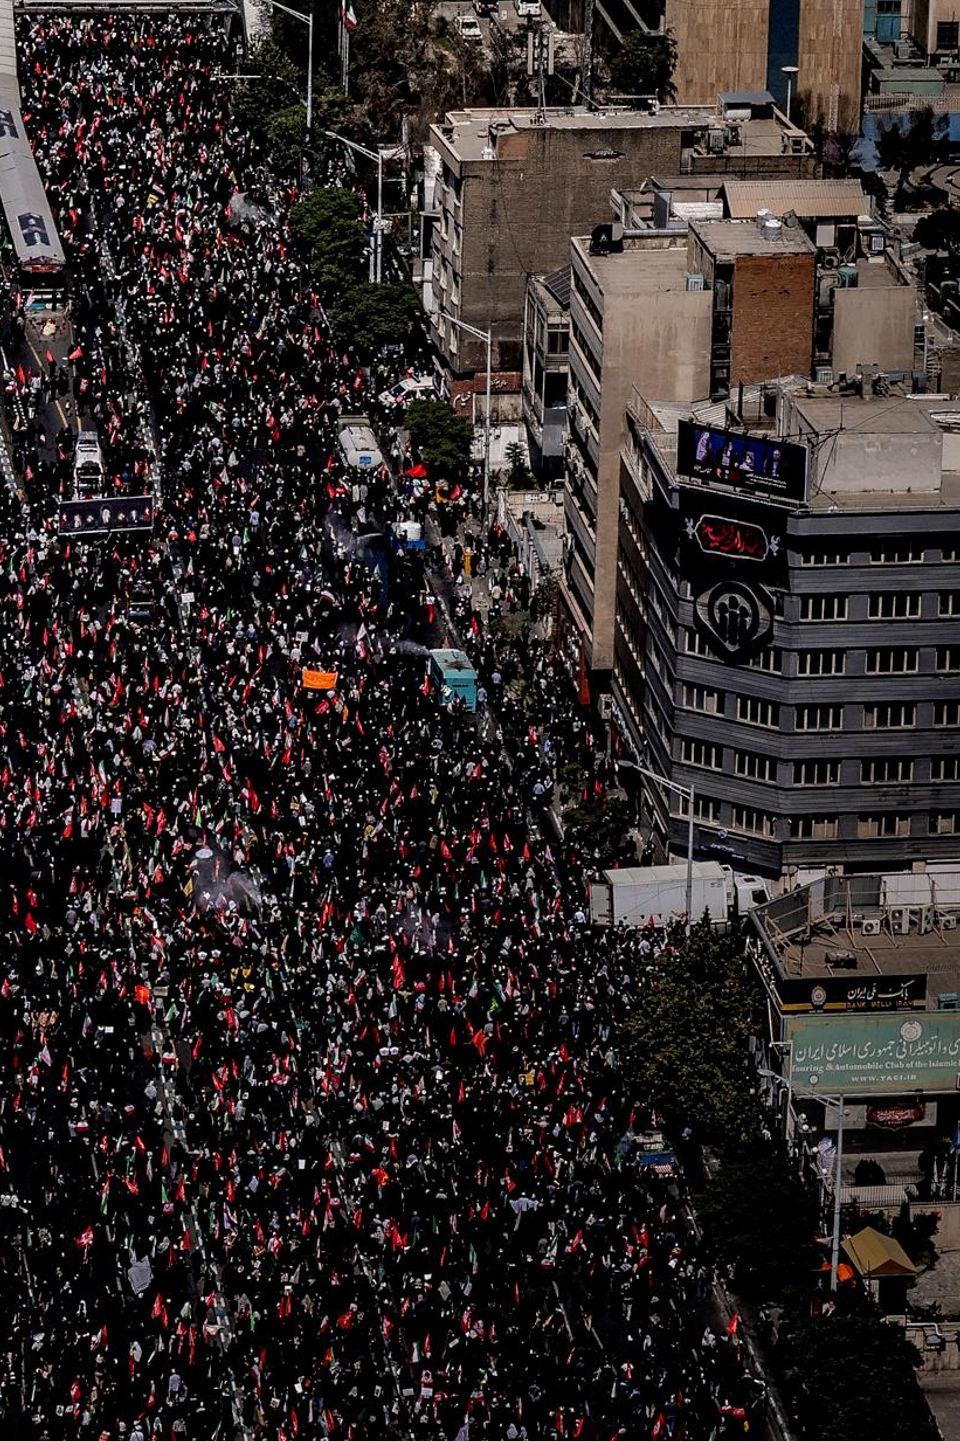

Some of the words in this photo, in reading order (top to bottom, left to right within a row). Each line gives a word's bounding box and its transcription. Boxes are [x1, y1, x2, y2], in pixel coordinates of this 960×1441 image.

[846, 986, 866, 999] ایران
[865, 983, 878, 1001] ملی
[877, 979, 915, 998] بانک
[795, 1044, 824, 1062] ایران
[826, 1042, 857, 1061] اسلامی
[857, 1040, 895, 1060] جمهوری
[825, 1063, 834, 1071] &
[835, 1062, 884, 1071] Automobile
[885, 1061, 904, 1070] Club
[906, 1061, 914, 1069] of
[914, 1060, 928, 1068] the
[929, 1060, 957, 1068] Islamic
